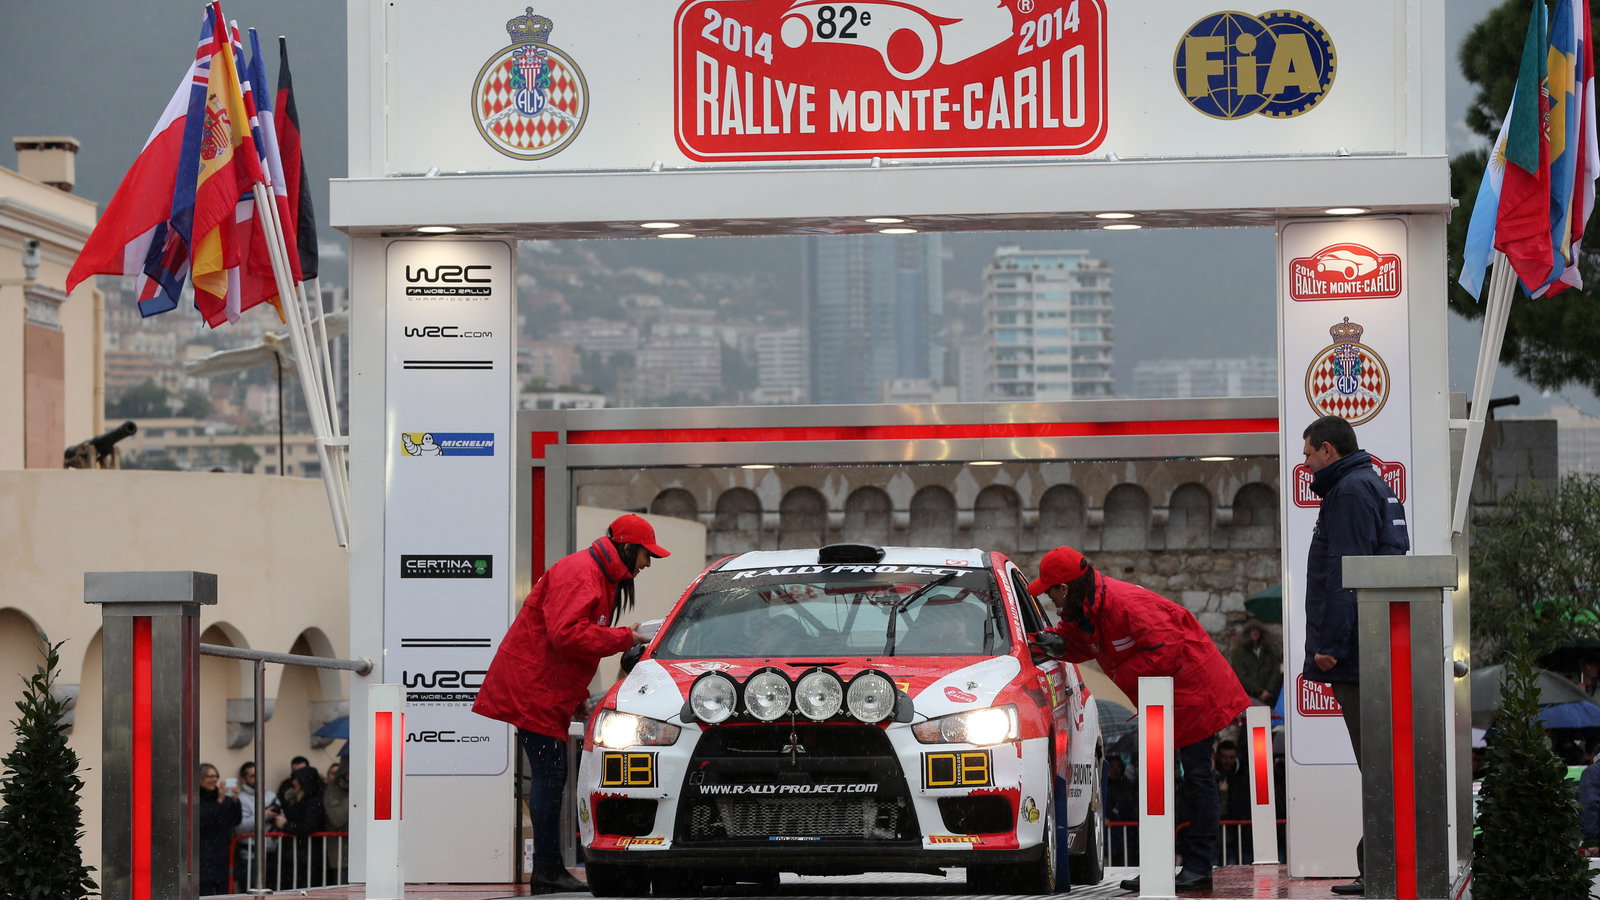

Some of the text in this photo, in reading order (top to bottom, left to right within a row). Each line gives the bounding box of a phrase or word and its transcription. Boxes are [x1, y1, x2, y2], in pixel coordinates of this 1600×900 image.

[701, 8, 773, 65] 2014
[1017, 4, 1080, 55] 2014
[696, 44, 1086, 136] RALLYE MONTE-CARLO
[405, 264, 492, 283] WRC
[1295, 264, 1315, 279] 2014
[1378, 260, 1396, 275] 2014
[1295, 269, 1397, 295] RALLYE MONTE-CARLO
[1299, 470, 1313, 482] 201
[1383, 468, 1400, 482] 2014
[405, 559, 473, 568] CERTINA
[403, 670, 488, 689] WRC
[1303, 680, 1322, 694] 2014
[1303, 688, 1335, 710] RALLYE
[603, 754, 652, 785] DB
[928, 753, 988, 786] DB
